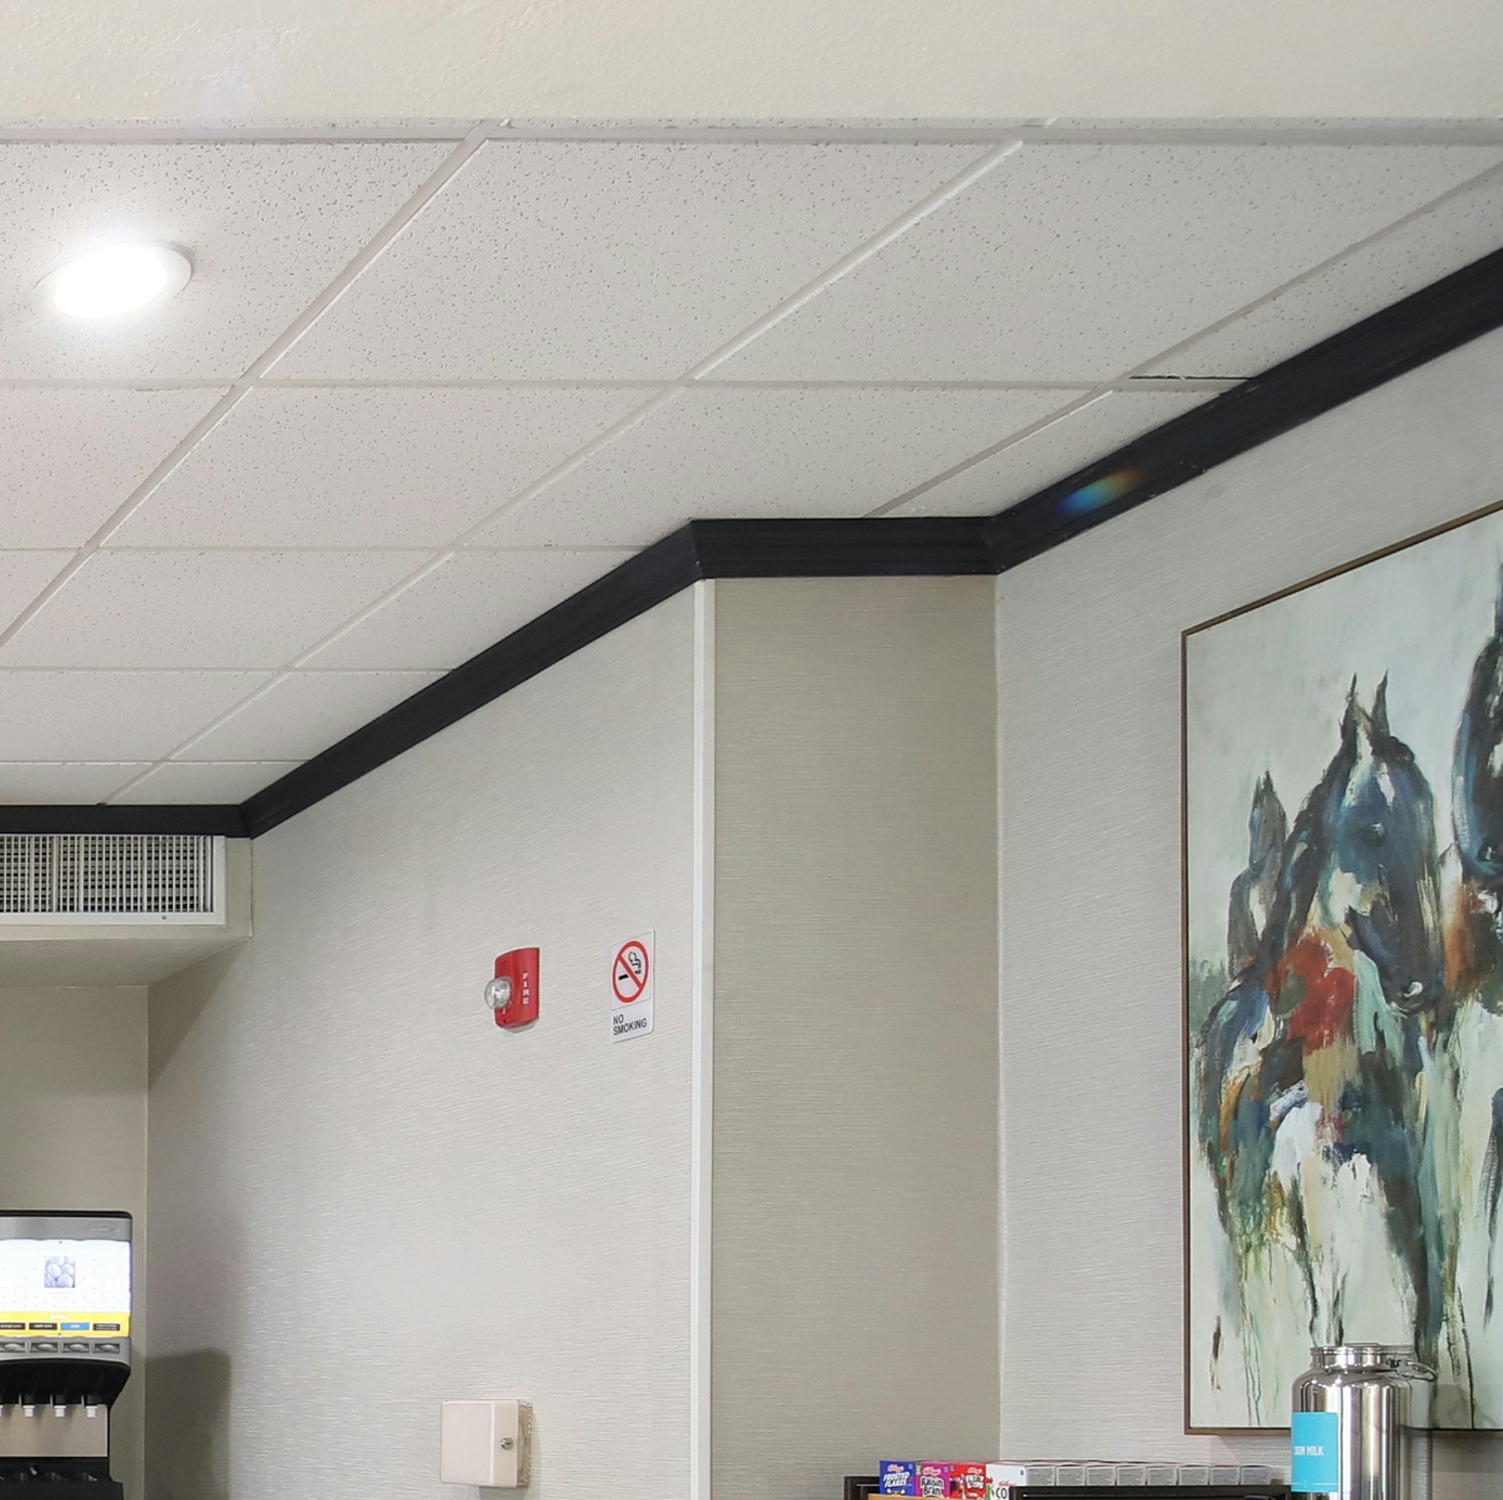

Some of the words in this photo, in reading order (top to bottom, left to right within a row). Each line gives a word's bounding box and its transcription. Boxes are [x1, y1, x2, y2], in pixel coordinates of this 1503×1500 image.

[522, 972, 531, 1005] FIRE
[613, 1014, 624, 1026] NO
[613, 1018, 647, 1036] SMOKING
[883, 1472, 910, 1481] FROSTED
[921, 1476, 944, 1488] Raisin
[995, 1487, 1009, 1497] CO
